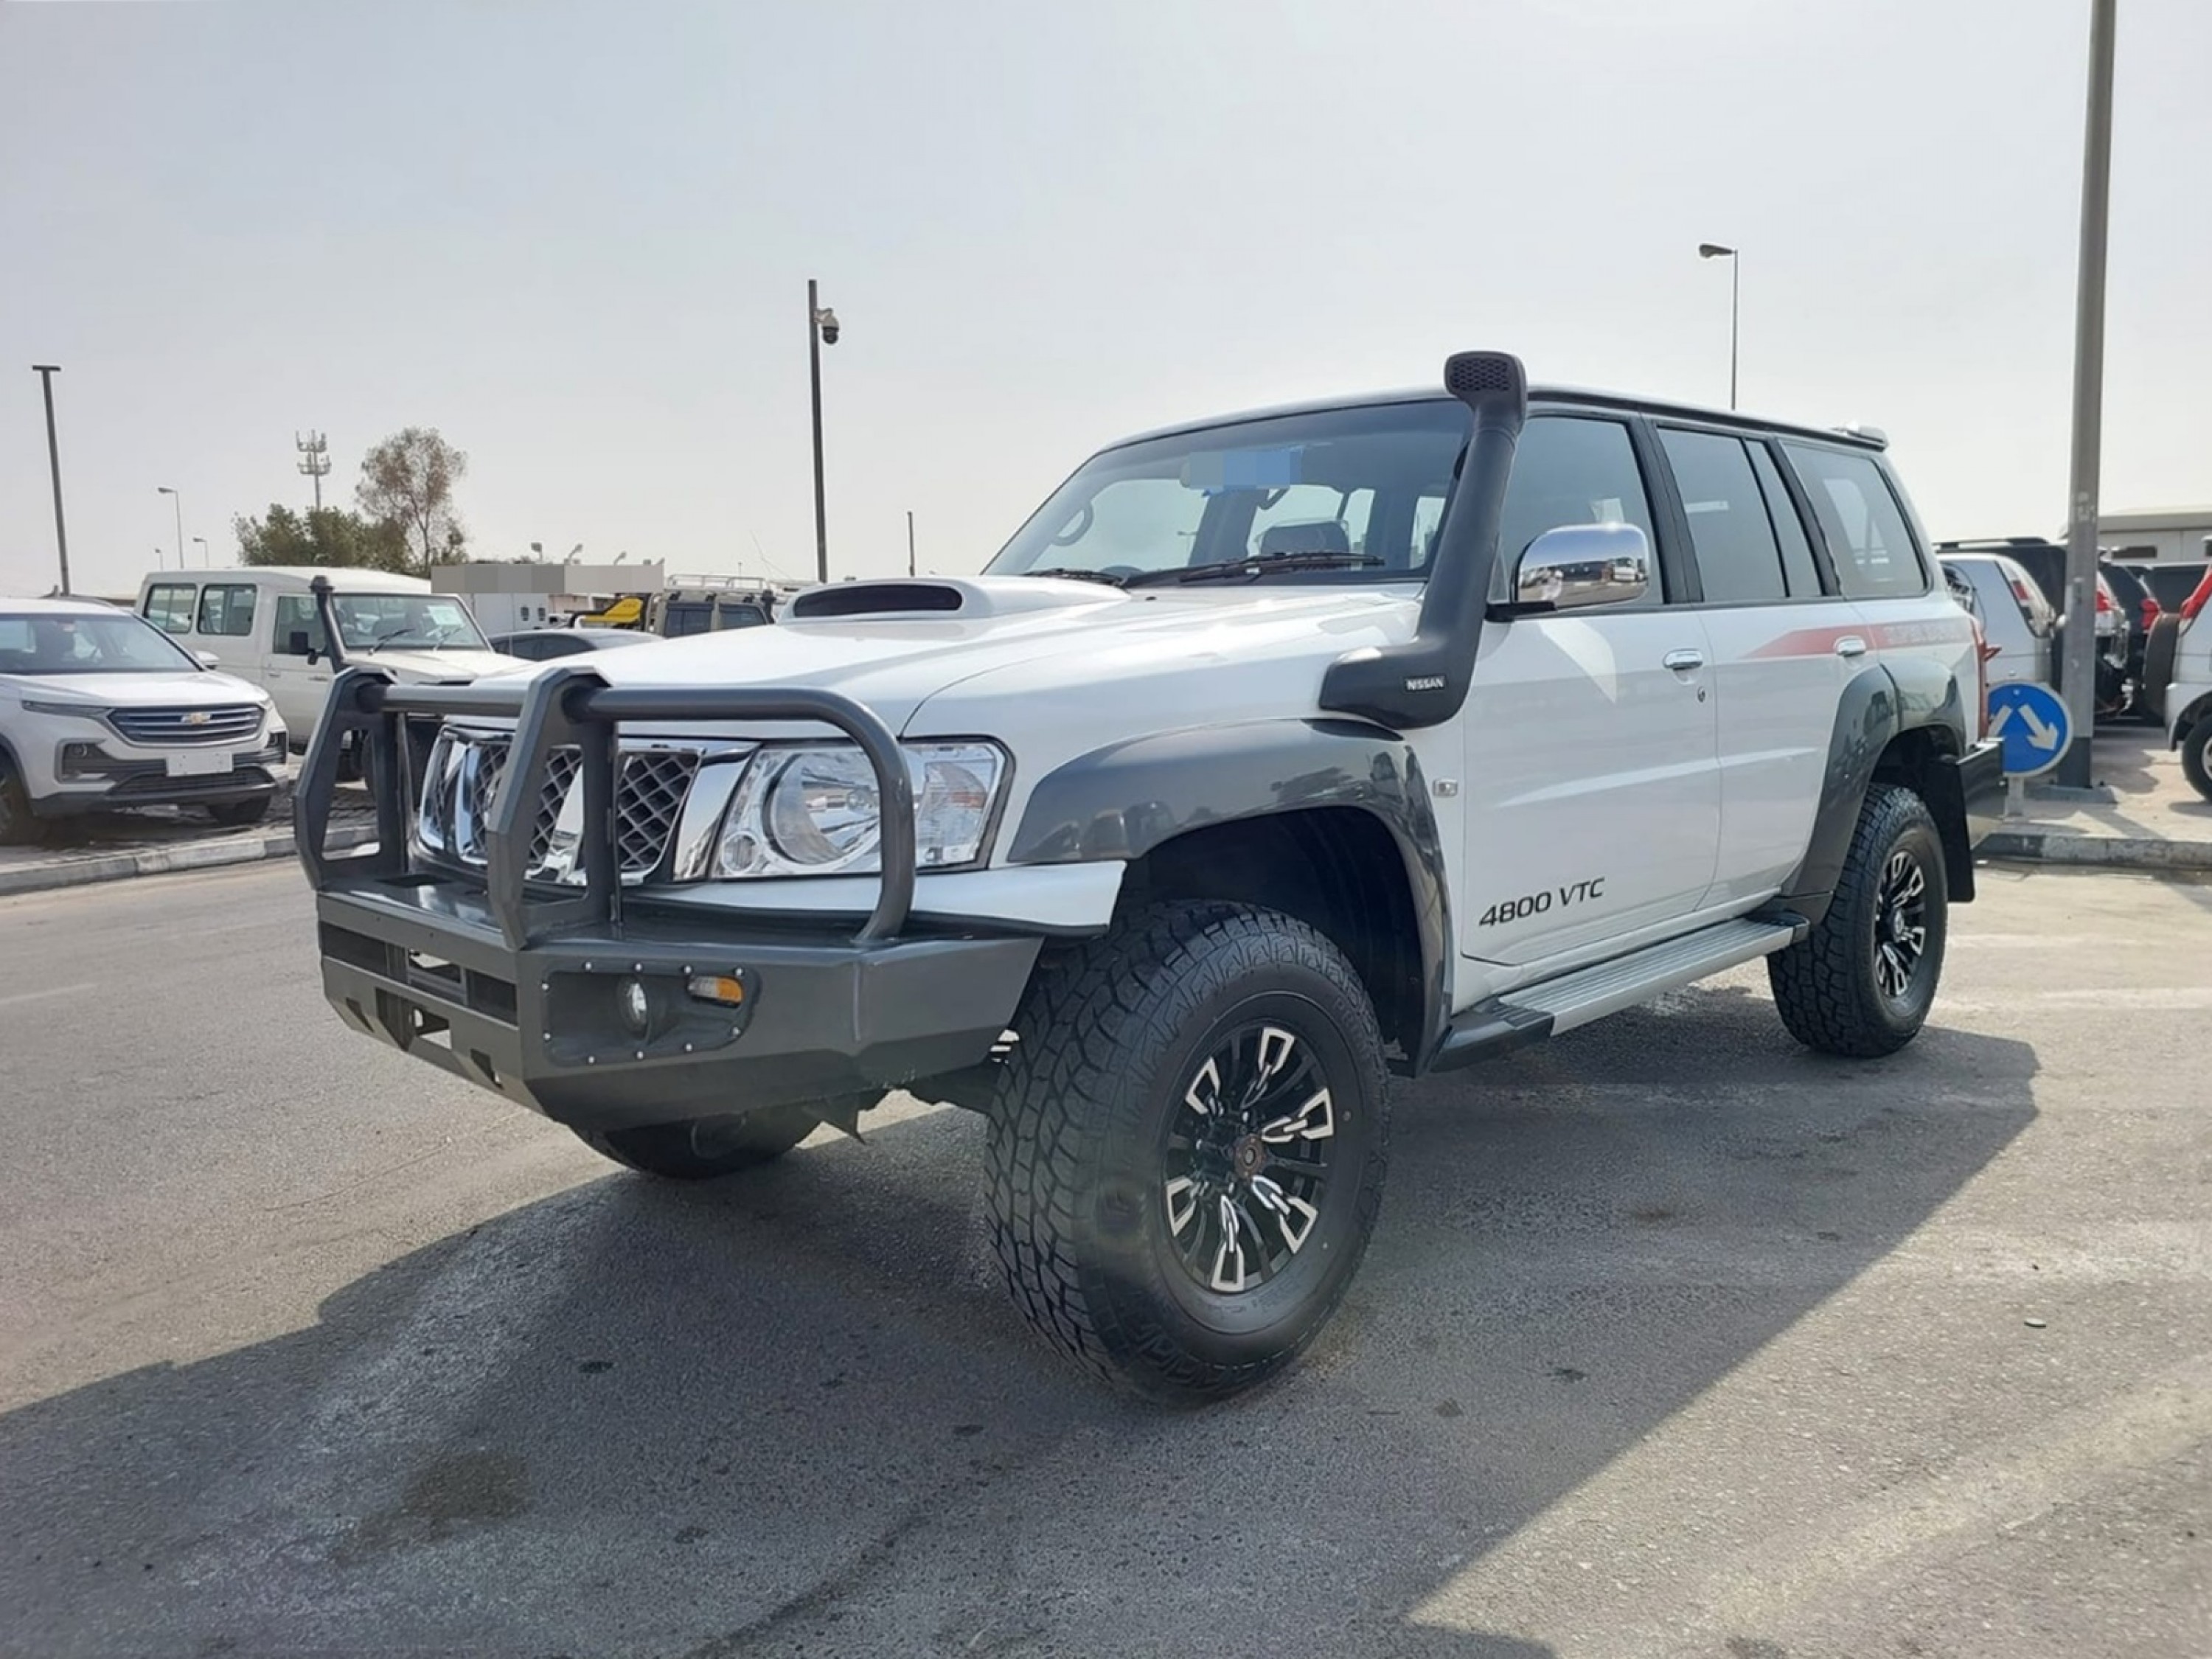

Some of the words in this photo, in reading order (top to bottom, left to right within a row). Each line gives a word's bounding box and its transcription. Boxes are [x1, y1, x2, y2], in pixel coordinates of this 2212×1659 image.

[1405, 677, 1444, 690] NISSAN
[1479, 891, 1552, 926] 4800
[1559, 876, 1605, 906] VTC
